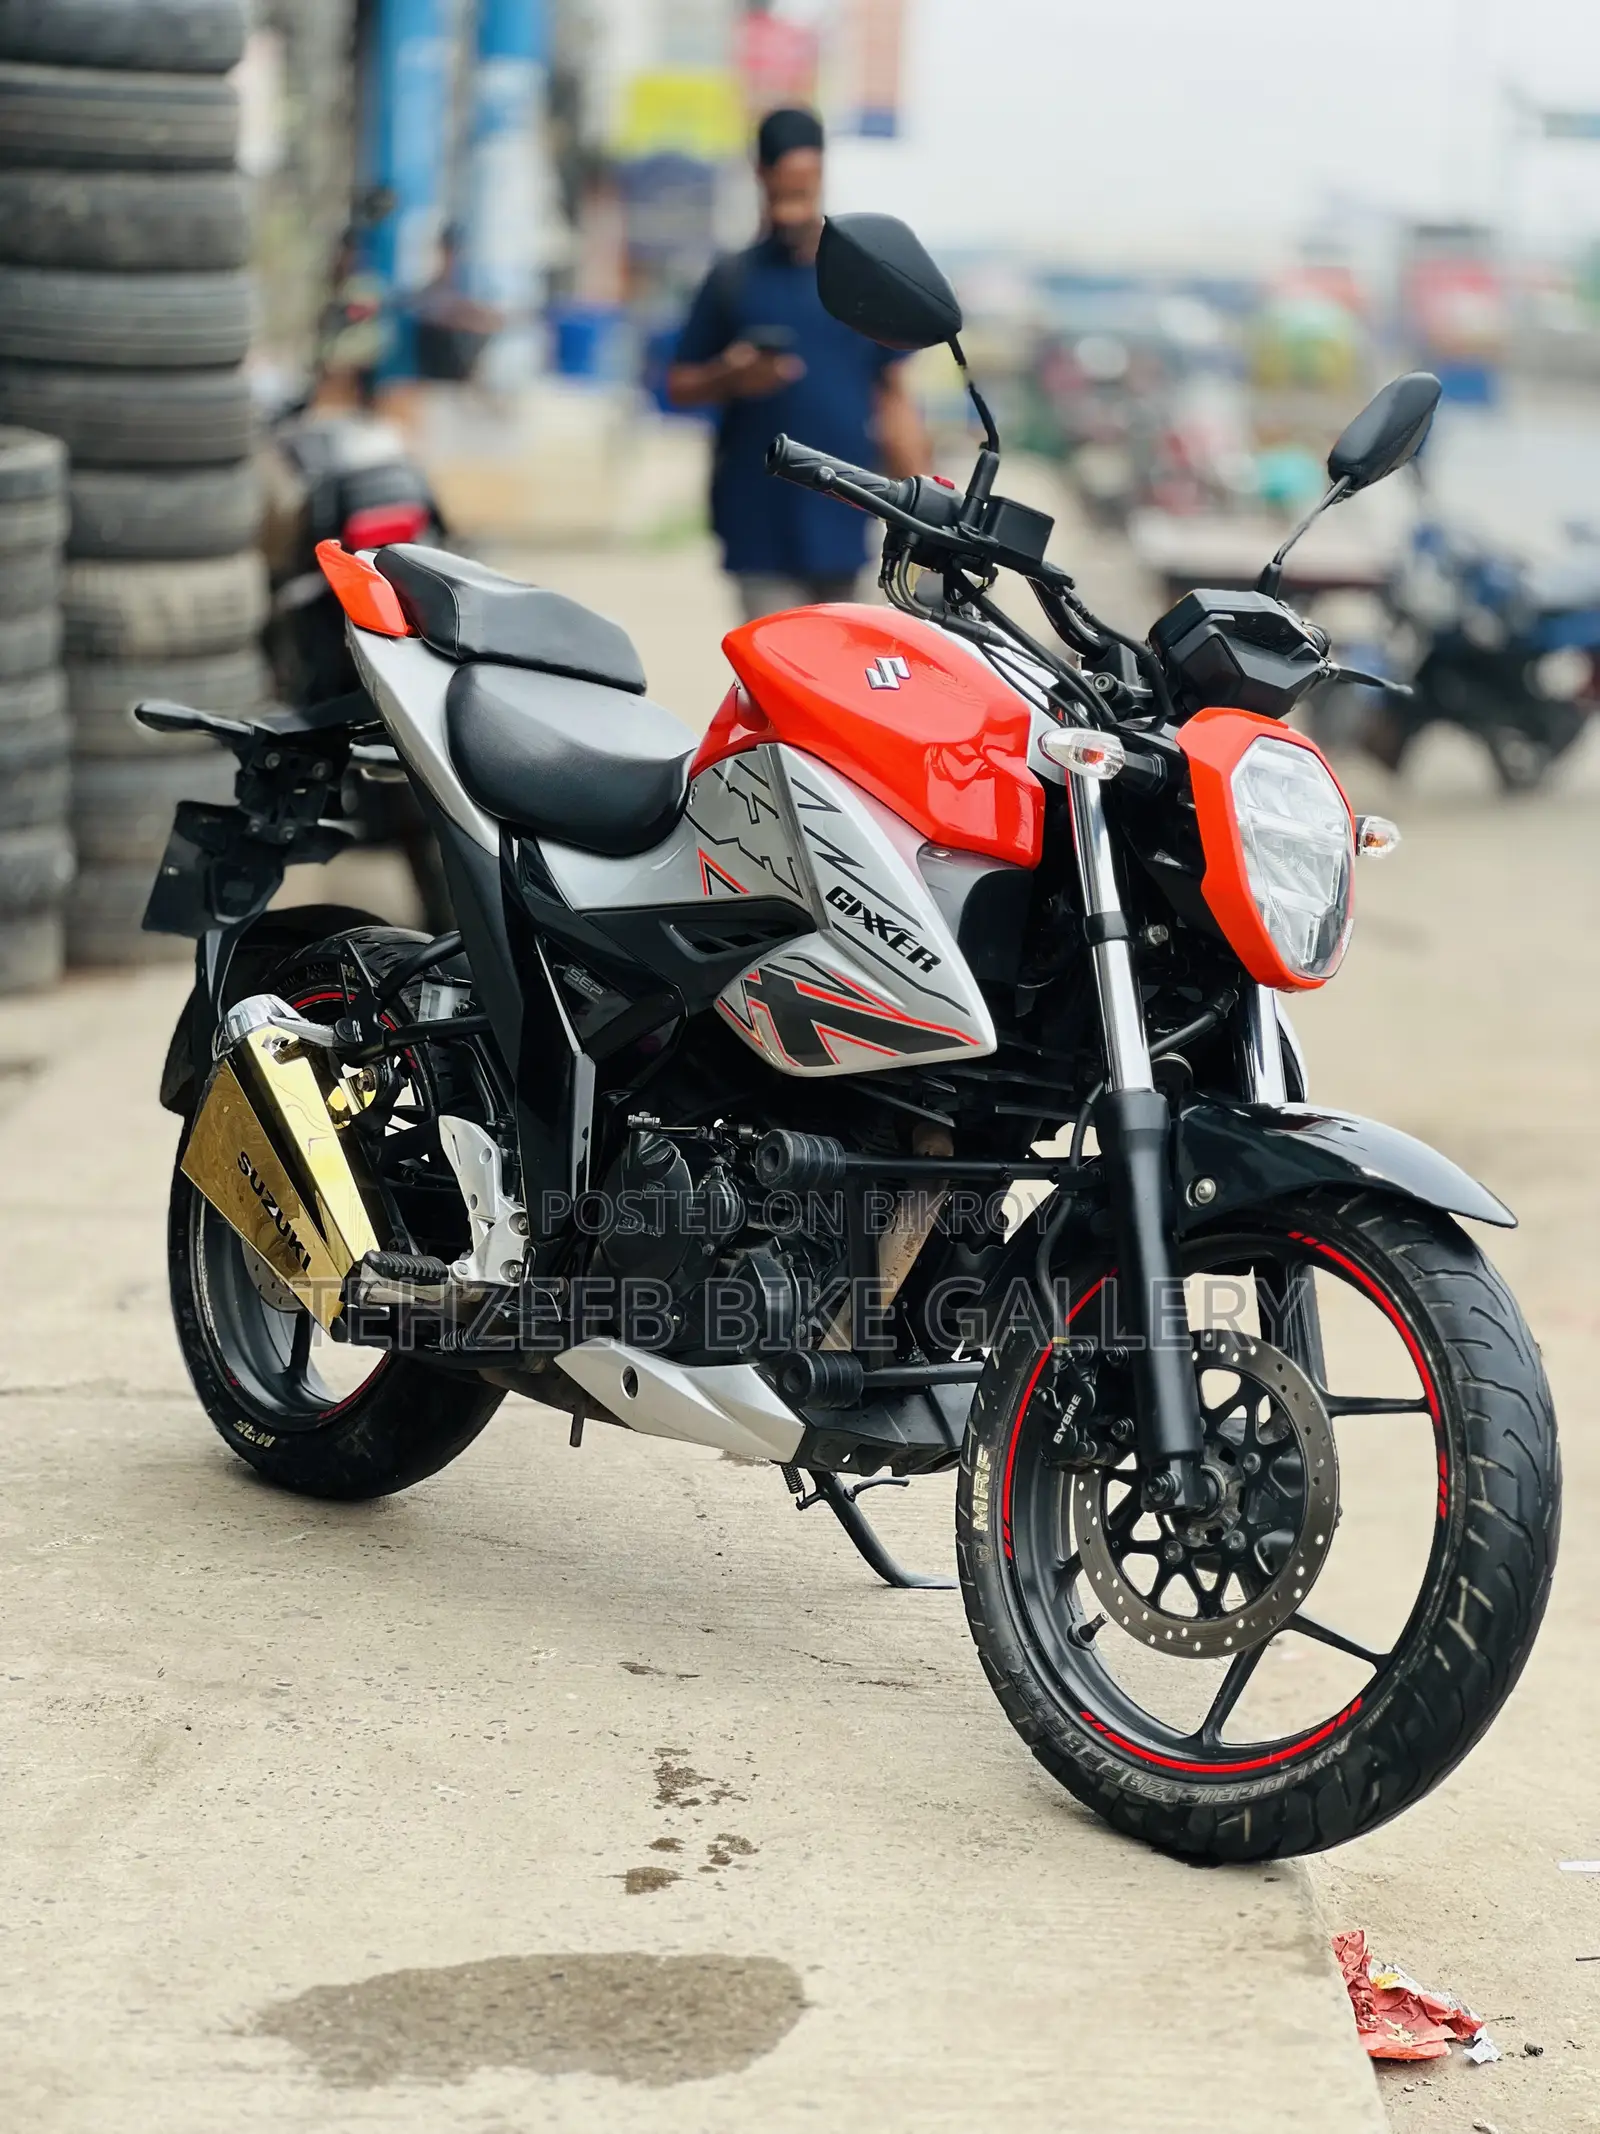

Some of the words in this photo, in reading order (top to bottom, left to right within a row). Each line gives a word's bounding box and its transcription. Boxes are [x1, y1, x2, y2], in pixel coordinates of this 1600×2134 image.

[825, 886, 942, 974] GIXXER
[237, 1151, 312, 1272] SUZUKI
[1053, 1394, 1082, 1444] BYBRE
[972, 1444, 992, 1532] MRF
